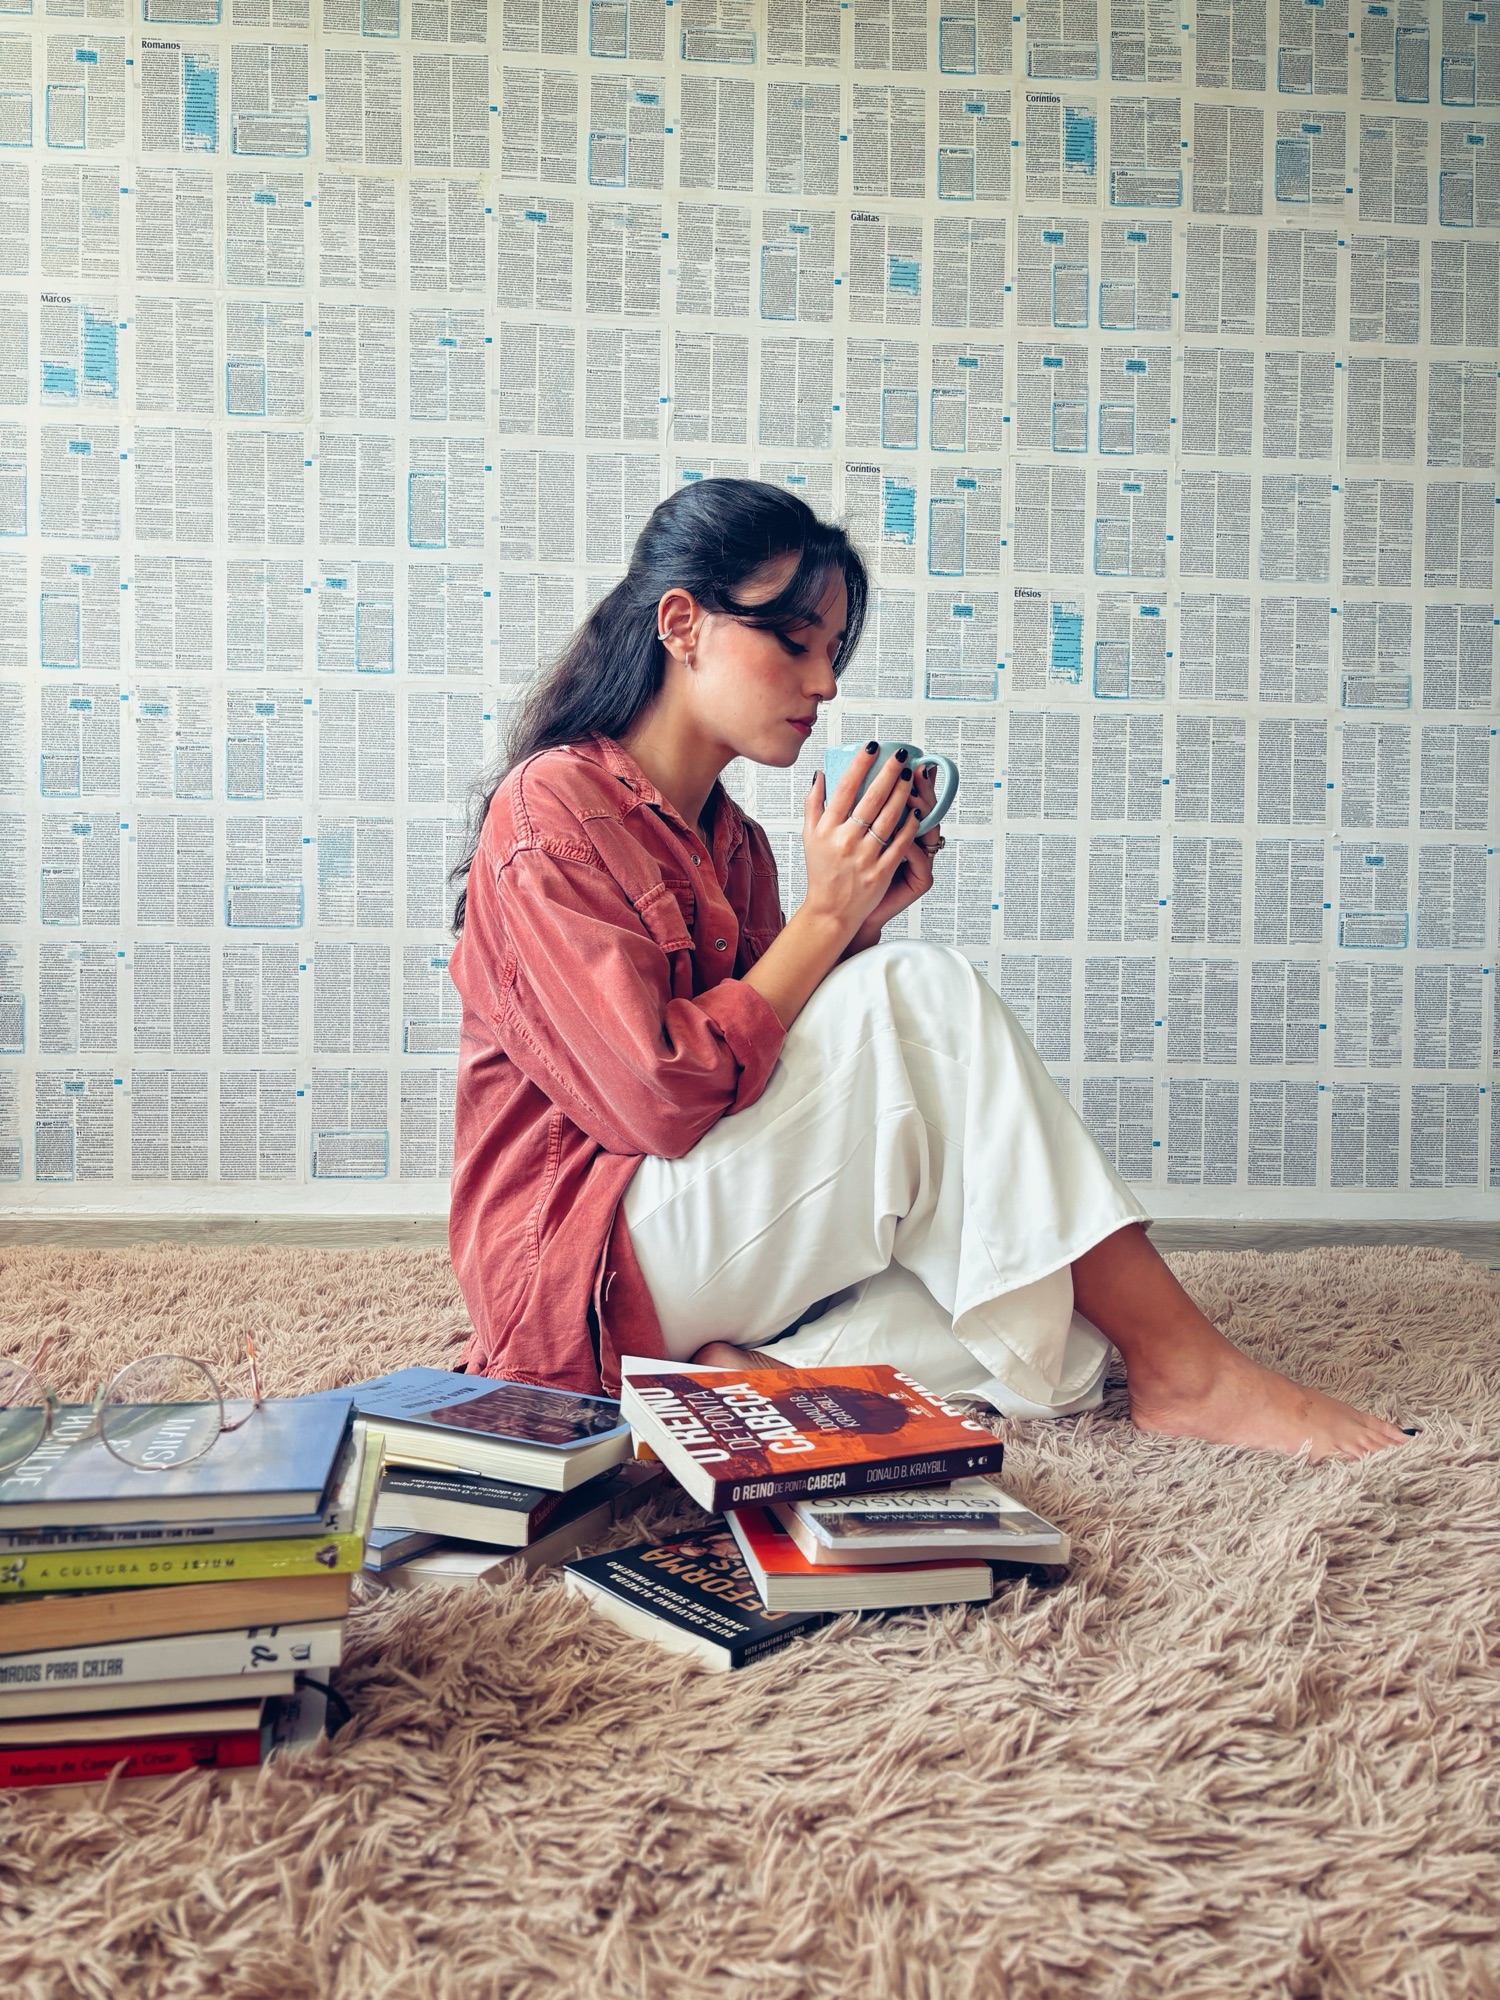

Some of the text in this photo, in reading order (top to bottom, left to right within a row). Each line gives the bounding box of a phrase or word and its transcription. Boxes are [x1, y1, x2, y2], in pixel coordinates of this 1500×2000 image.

[142, 40, 180, 50] Romanos
[1026, 94, 1061, 103] Coríntios
[850, 212, 880, 223] Gálatas
[40, 295, 71, 303] Marcos
[845, 464, 880, 473] Coríntios
[1014, 590, 1041, 598] Efésios
[684, 1390, 762, 1451] DE PONTA
[712, 1382, 816, 1455] CABEÇA
[801, 1403, 841, 1432] DONALD
[1, 1415, 97, 1488] HUMILDE
[133, 1418, 196, 1475] MANSO
[867, 1459, 947, 1483] DONALD B. KRAYBILL
[733, 1472, 846, 1502] O REINO DE PONTA CABEÇA
[811, 1498, 1001, 1508] ISLAMISMO
[41, 1568, 48, 1577] A
[60, 1561, 139, 1577] CULTURA
[149, 1561, 173, 1572] DO
[606, 1560, 751, 1632] JAQUELINE SOUSA PINHEIRO
[609, 1573, 736, 1639] RUTE SALVIANO ALMEIDA
[45, 1660, 79, 1680] PARA
